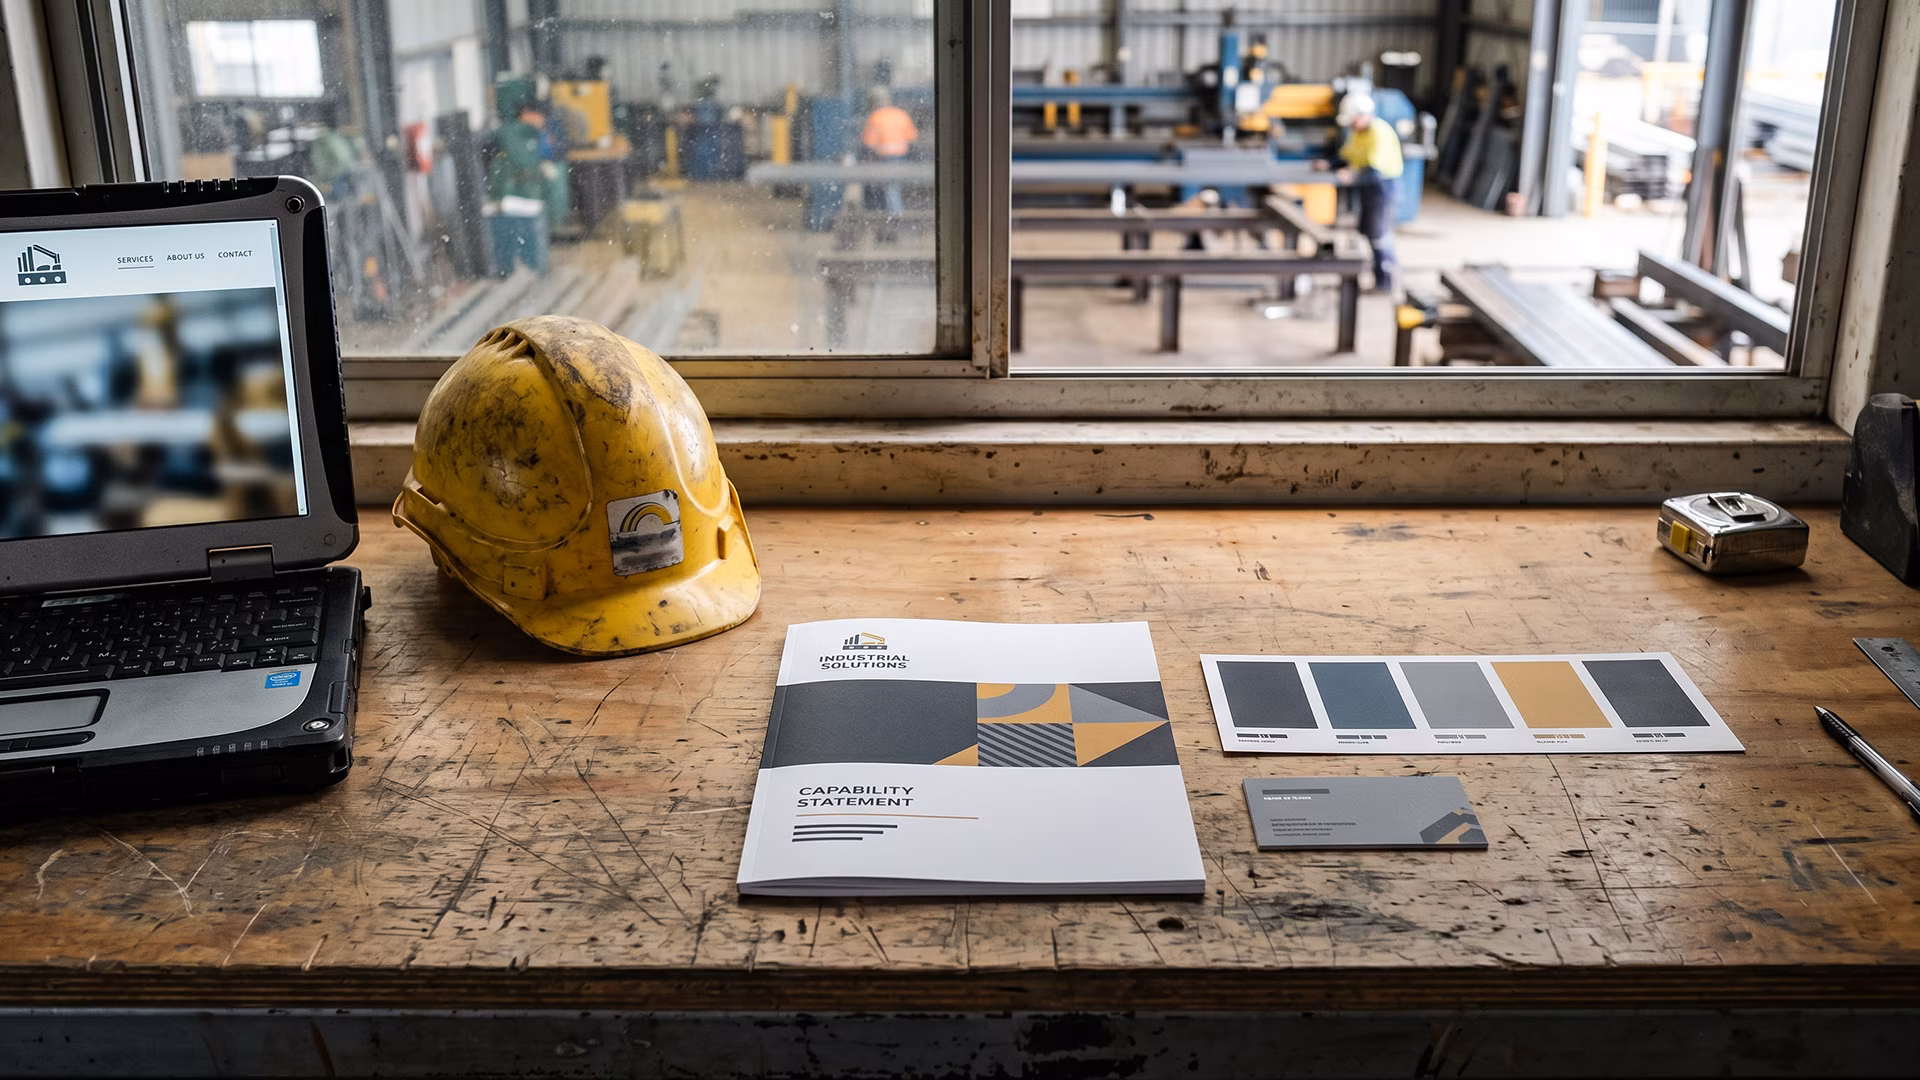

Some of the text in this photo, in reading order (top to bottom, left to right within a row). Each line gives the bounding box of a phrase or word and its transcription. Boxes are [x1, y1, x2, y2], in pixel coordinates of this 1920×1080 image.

[117, 250, 253, 264] SERVICES ABOUT US CONTACT
[819, 654, 910, 662] INDUSTRIAL
[821, 661, 907, 670] SOLUTIONS
[798, 786, 914, 795] CAPABILITY
[797, 797, 913, 807] STATEMENT
